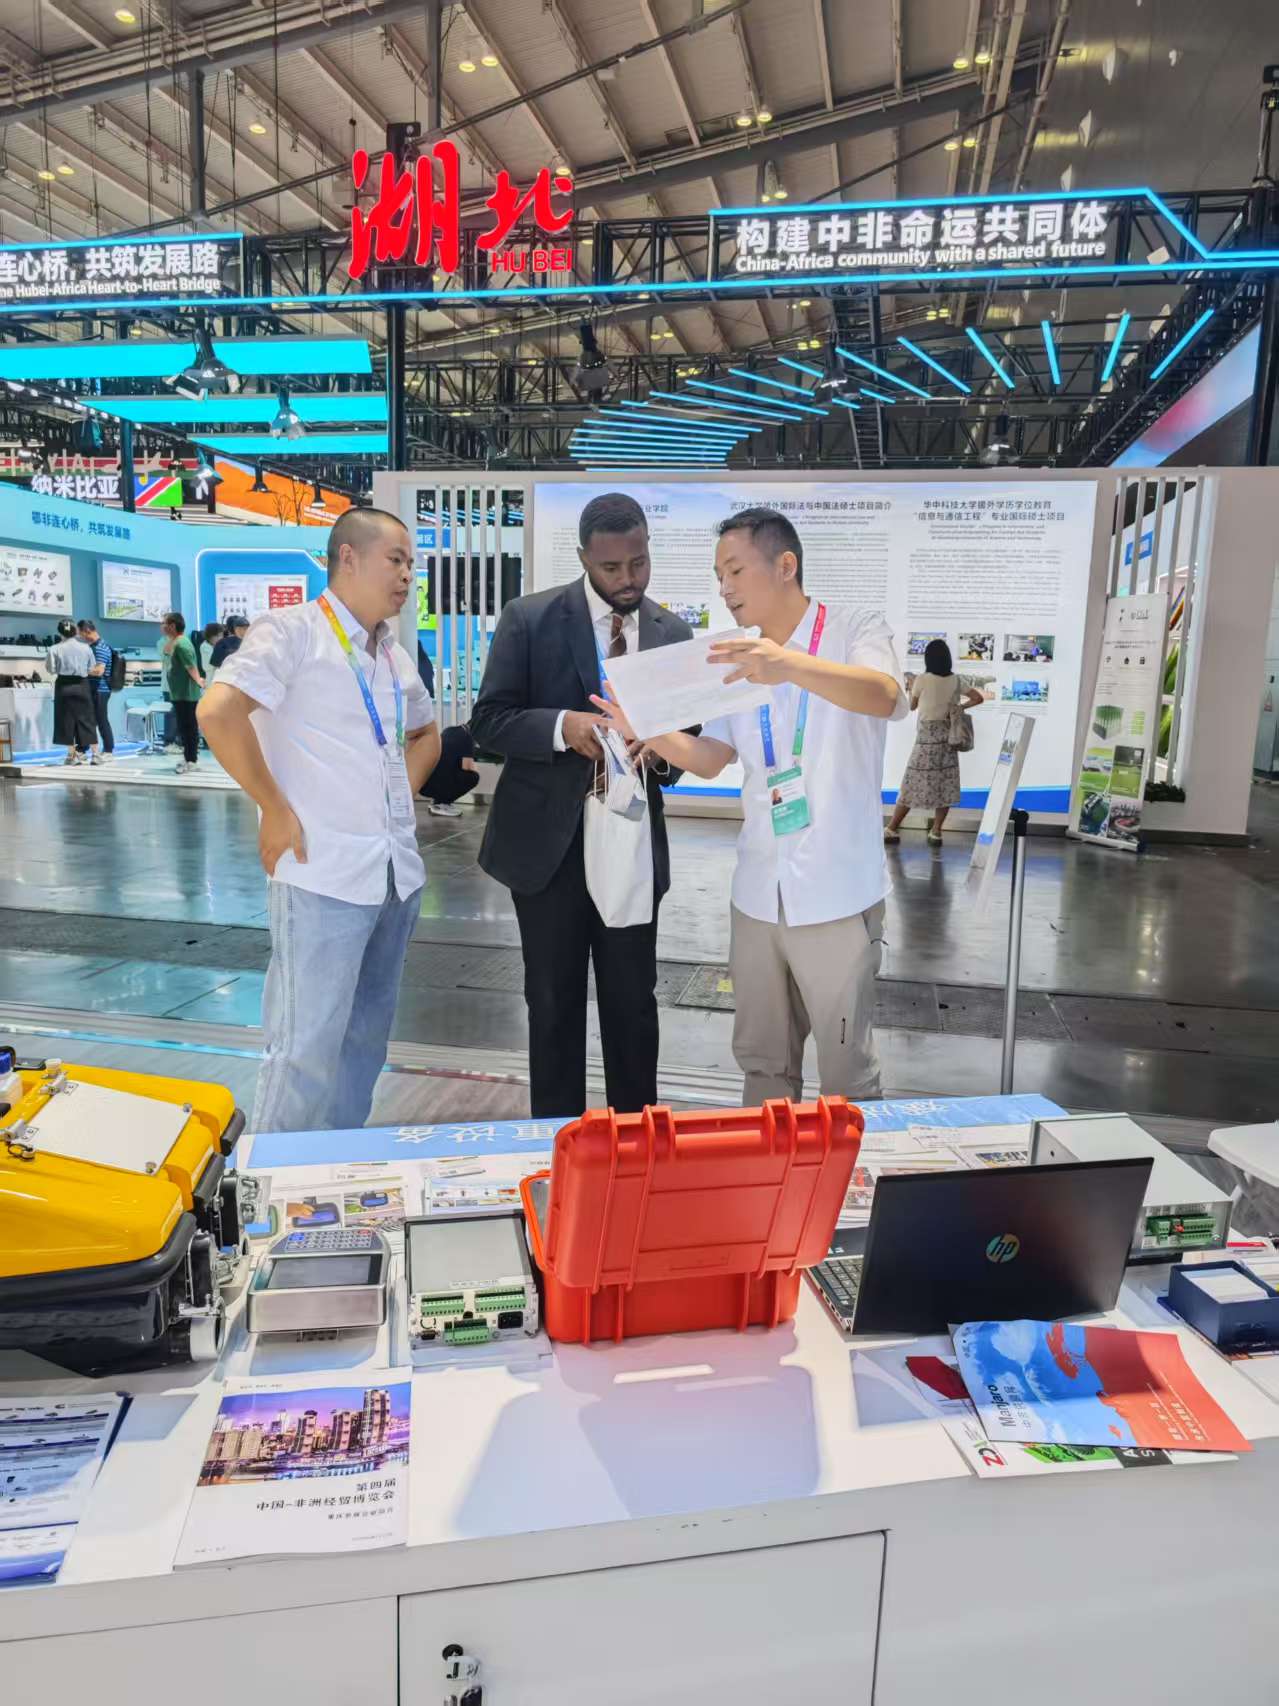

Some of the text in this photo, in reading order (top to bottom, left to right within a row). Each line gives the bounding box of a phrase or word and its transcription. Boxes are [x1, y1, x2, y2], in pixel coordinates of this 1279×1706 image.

[348, 140, 574, 280] 湖北
[736, 200, 1108, 254] 构建中非命运共同体
[736, 240, 1106, 272] China-Africa community with a shared future
[16, 281, 87, 298] Hubei-Africa
[180, 276, 221, 293] Bridge
[31, 474, 121, 499] 纳米比亚
[986, 1233, 1019, 1263] hp
[988, 1384, 1017, 1427] Manjaro
[256, 1491, 395, 1512] 中国-非洲经贸博览会
